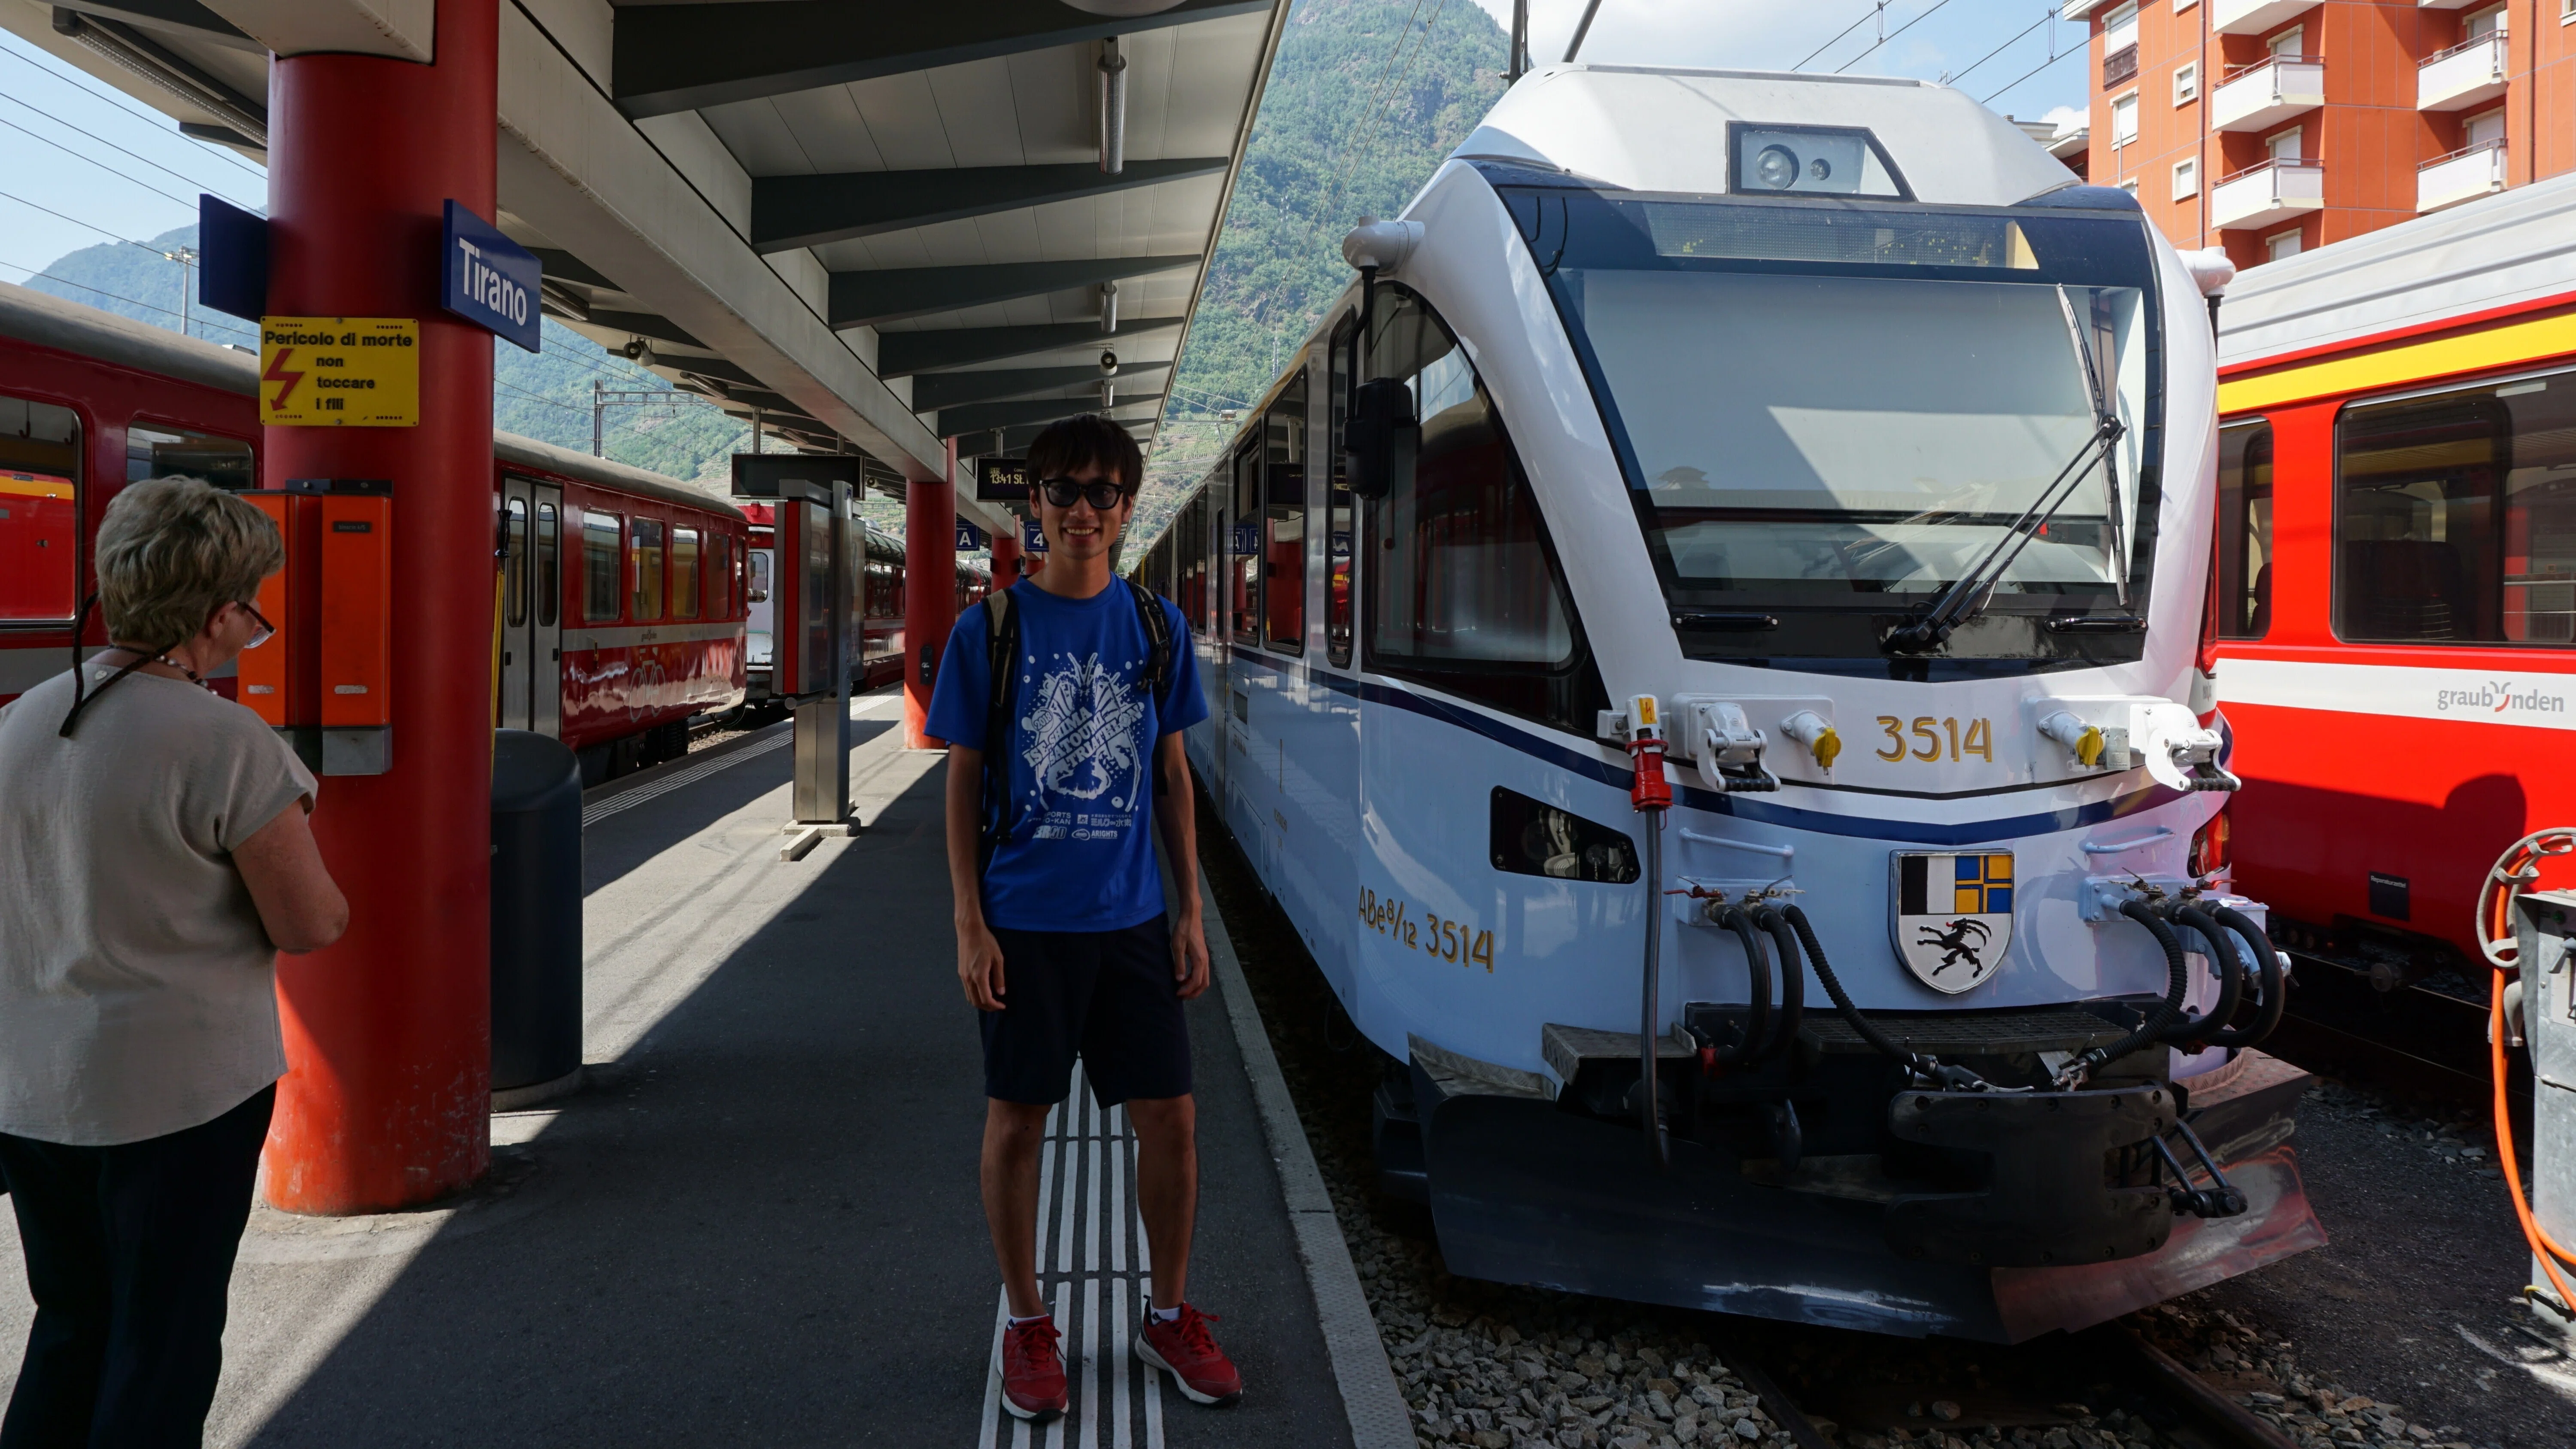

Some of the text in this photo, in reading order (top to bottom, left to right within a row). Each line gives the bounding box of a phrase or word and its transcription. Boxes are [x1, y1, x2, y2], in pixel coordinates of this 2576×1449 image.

[459, 237, 527, 326] Tirano
[264, 331, 413, 346] Pericolo di morte
[316, 357, 343, 367] non
[316, 376, 375, 389] toccare
[316, 398, 343, 410] i fili
[990, 474, 1011, 484] 13:41
[1013, 474, 1025, 484] St.
[959, 531, 972, 546] A
[1033, 532, 1045, 547] 4
[1033, 711, 1053, 731] 2018
[1049, 711, 1106, 766] SATOUMI
[1876, 715, 1993, 763] 3514
[1091, 829, 1118, 838] ARIGHTS
[1425, 913, 1494, 974] 3514
